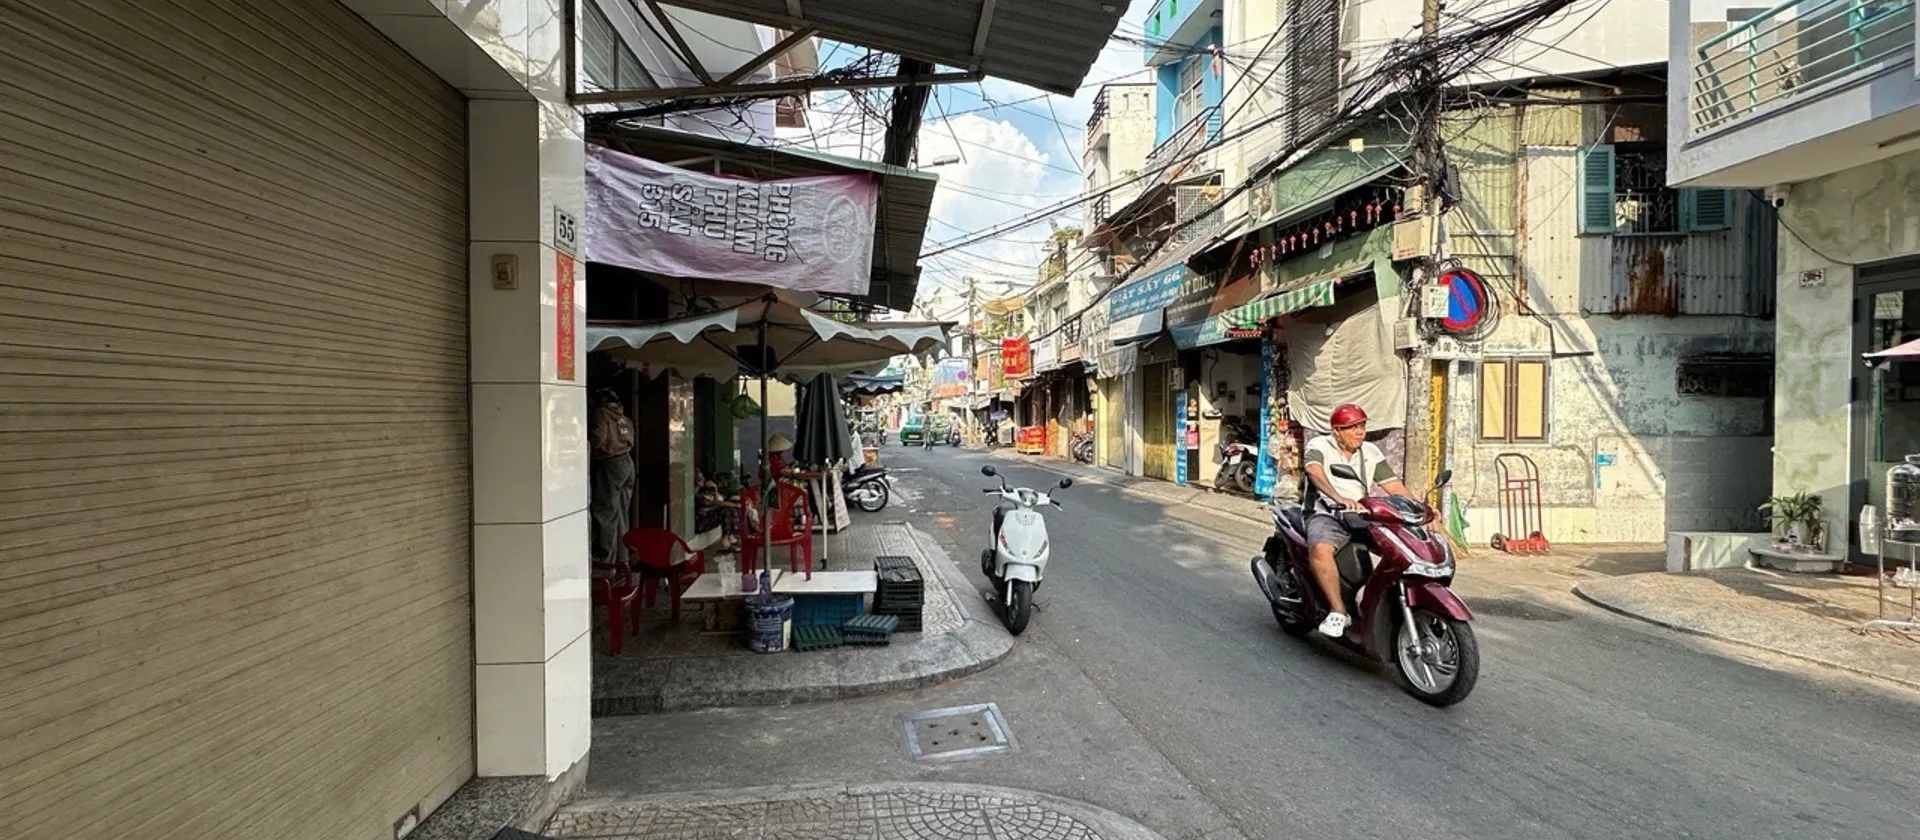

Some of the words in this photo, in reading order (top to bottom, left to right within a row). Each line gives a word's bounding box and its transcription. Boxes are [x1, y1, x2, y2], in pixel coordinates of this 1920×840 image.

[559, 216, 574, 243] 55
[638, 183, 665, 230] 315
[667, 183, 700, 237] SẢN
[698, 187, 729, 240] PHỤ
[732, 183, 763, 255] KHÁM
[763, 183, 796, 263] PHÒNG
